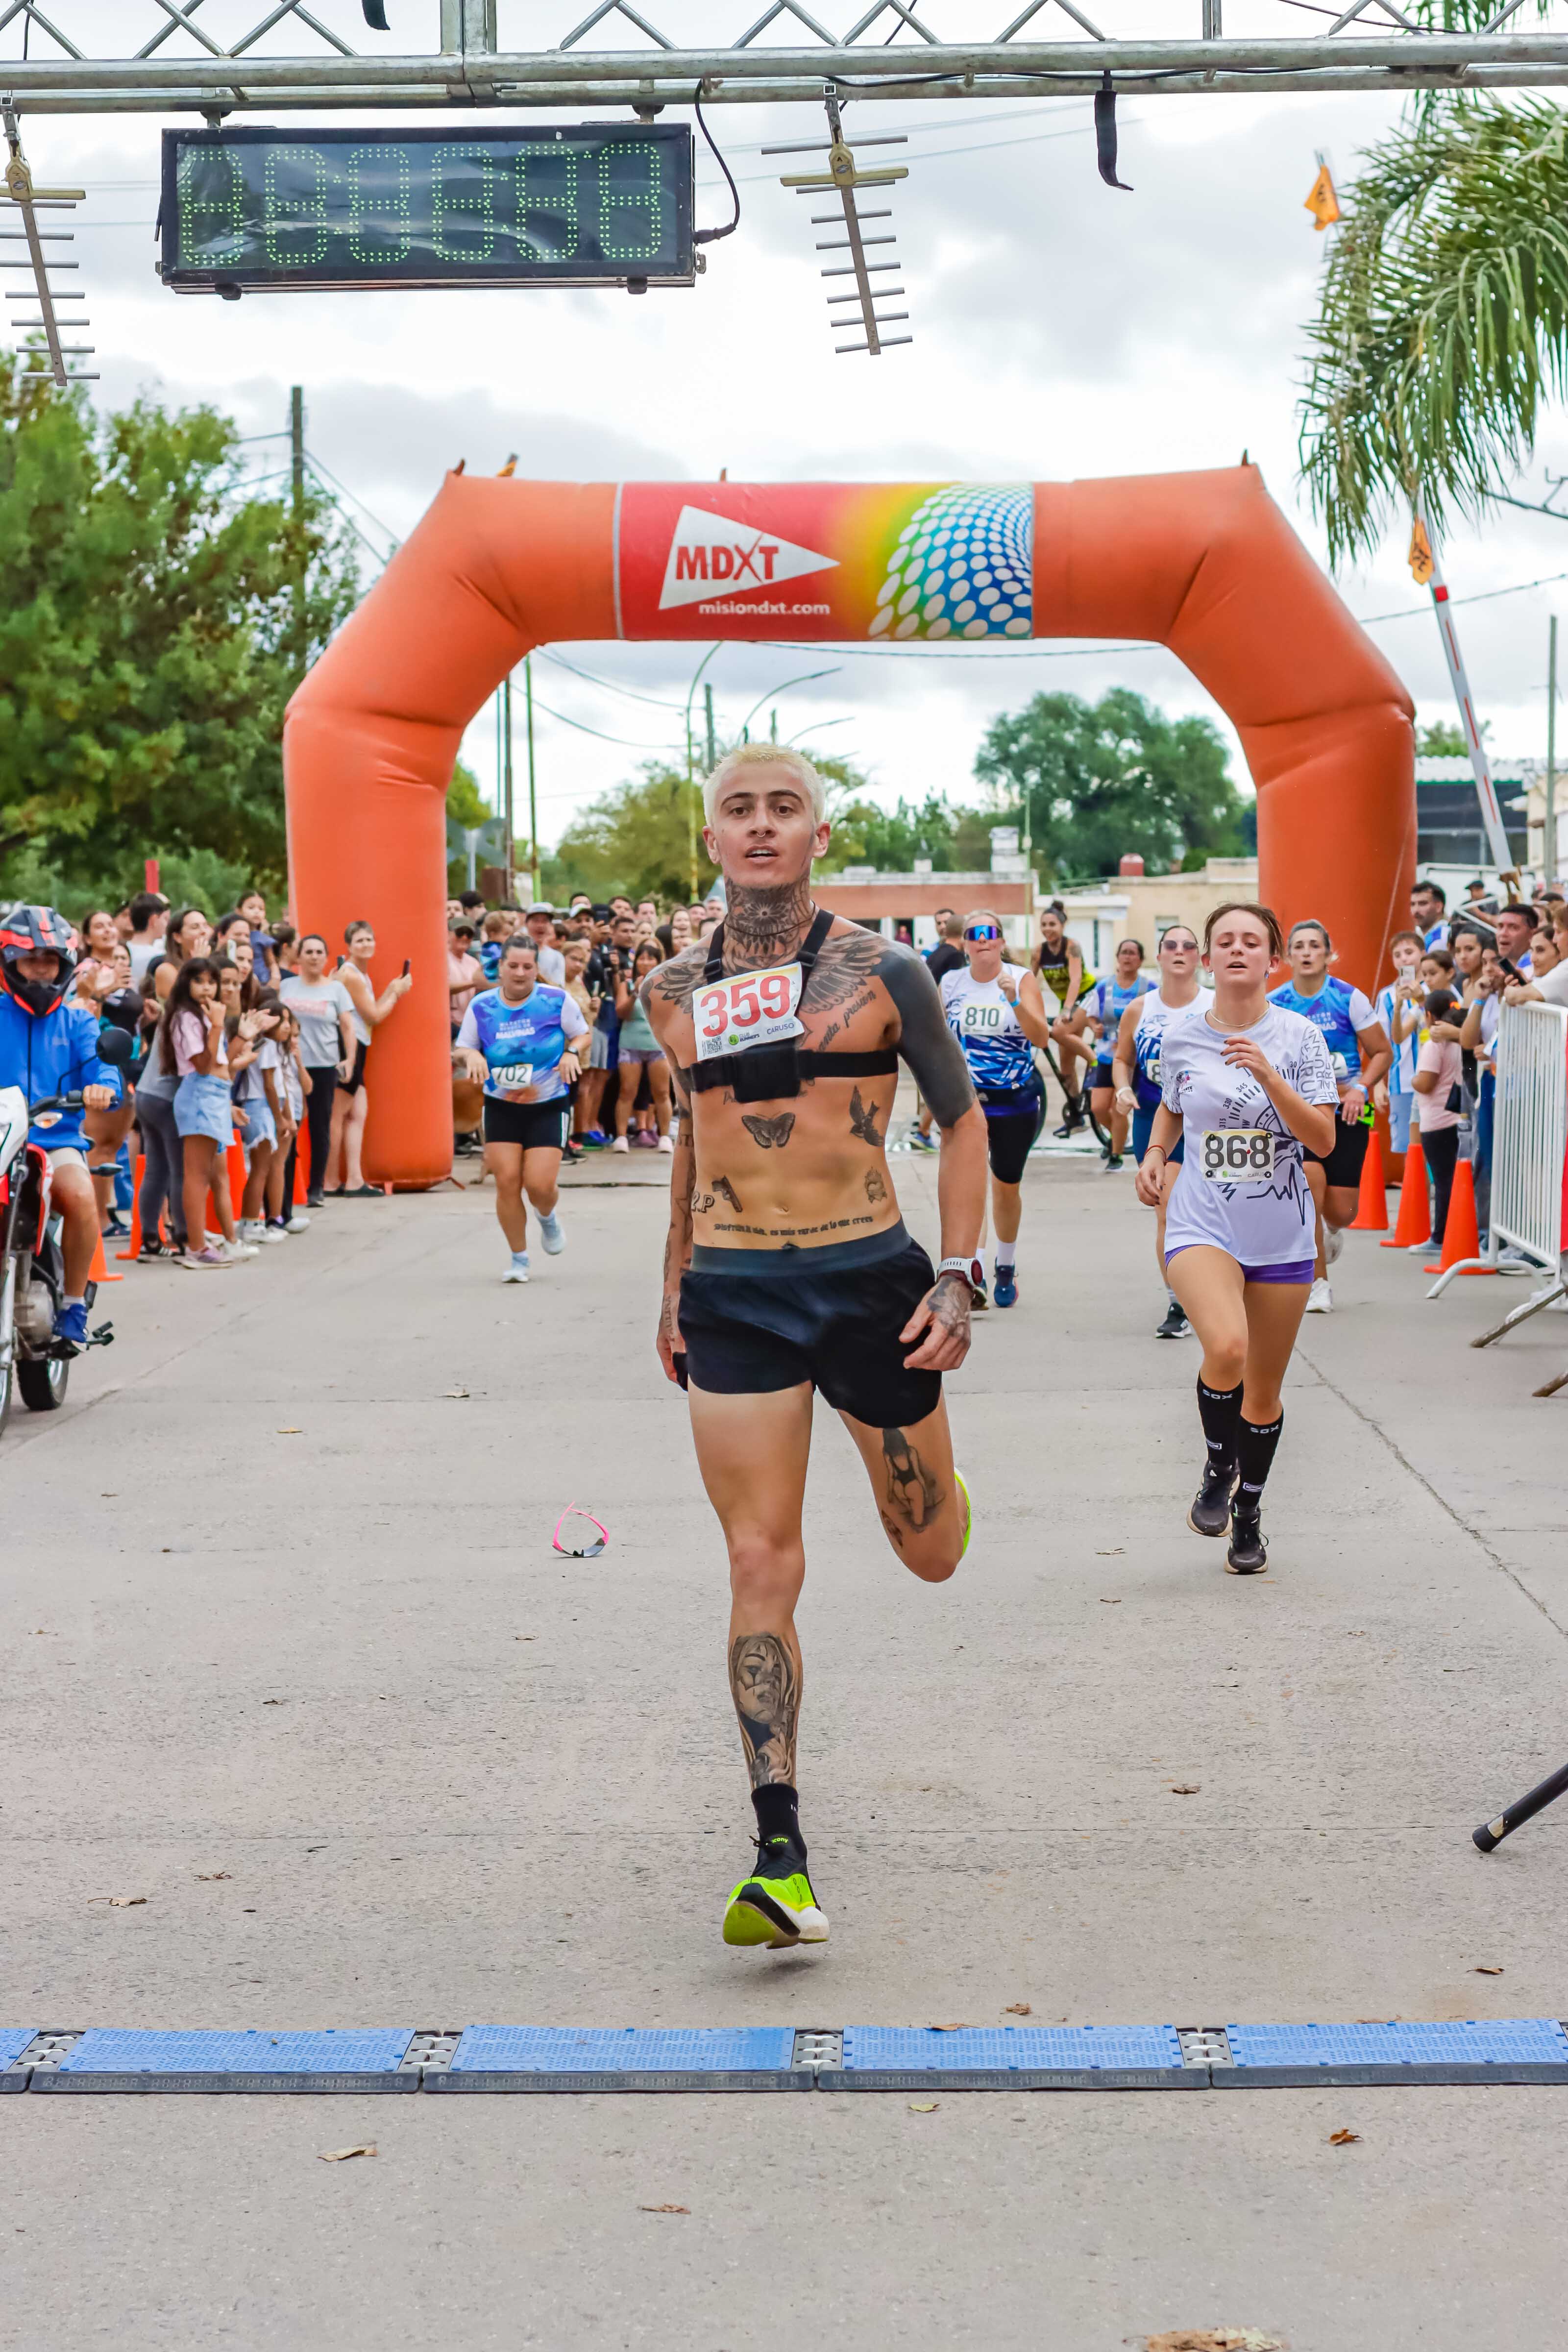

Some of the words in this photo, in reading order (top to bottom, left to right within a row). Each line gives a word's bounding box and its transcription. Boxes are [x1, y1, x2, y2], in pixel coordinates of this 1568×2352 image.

[676, 533, 779, 584] MDXT
[699, 601, 831, 615] misiondxt.com
[700, 975, 790, 1037] 359
[965, 1006, 1000, 1027] 810
[766, 1023, 795, 1035] CARUSO
[1236, 1082, 1248, 1093] 345
[1223, 1098, 1232, 1109] 330
[1205, 1135, 1271, 1169] 868
[1250, 1424, 1279, 1434] SOX
